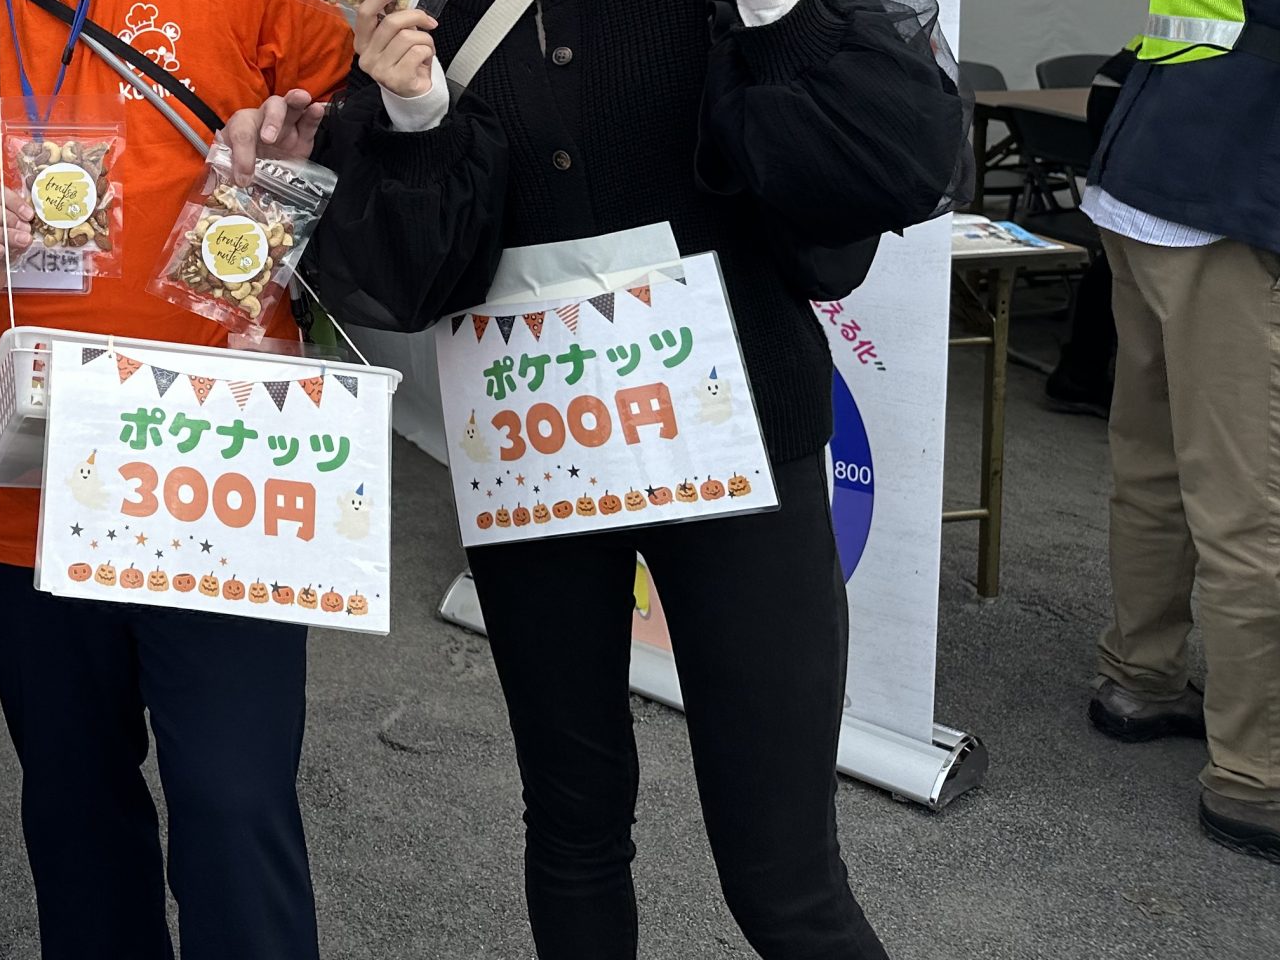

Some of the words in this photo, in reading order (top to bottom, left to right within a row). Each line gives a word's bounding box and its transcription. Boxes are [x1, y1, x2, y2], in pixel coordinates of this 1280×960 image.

[45, 195, 65, 212] nuts
[216, 248, 238, 266] nuts
[483, 326, 693, 401] ポケナッツ
[119, 406, 350, 472] ポケナッツ
[491, 382, 678, 461] 300円
[117, 461, 317, 541] 300円
[834, 460, 872, 485] 800
